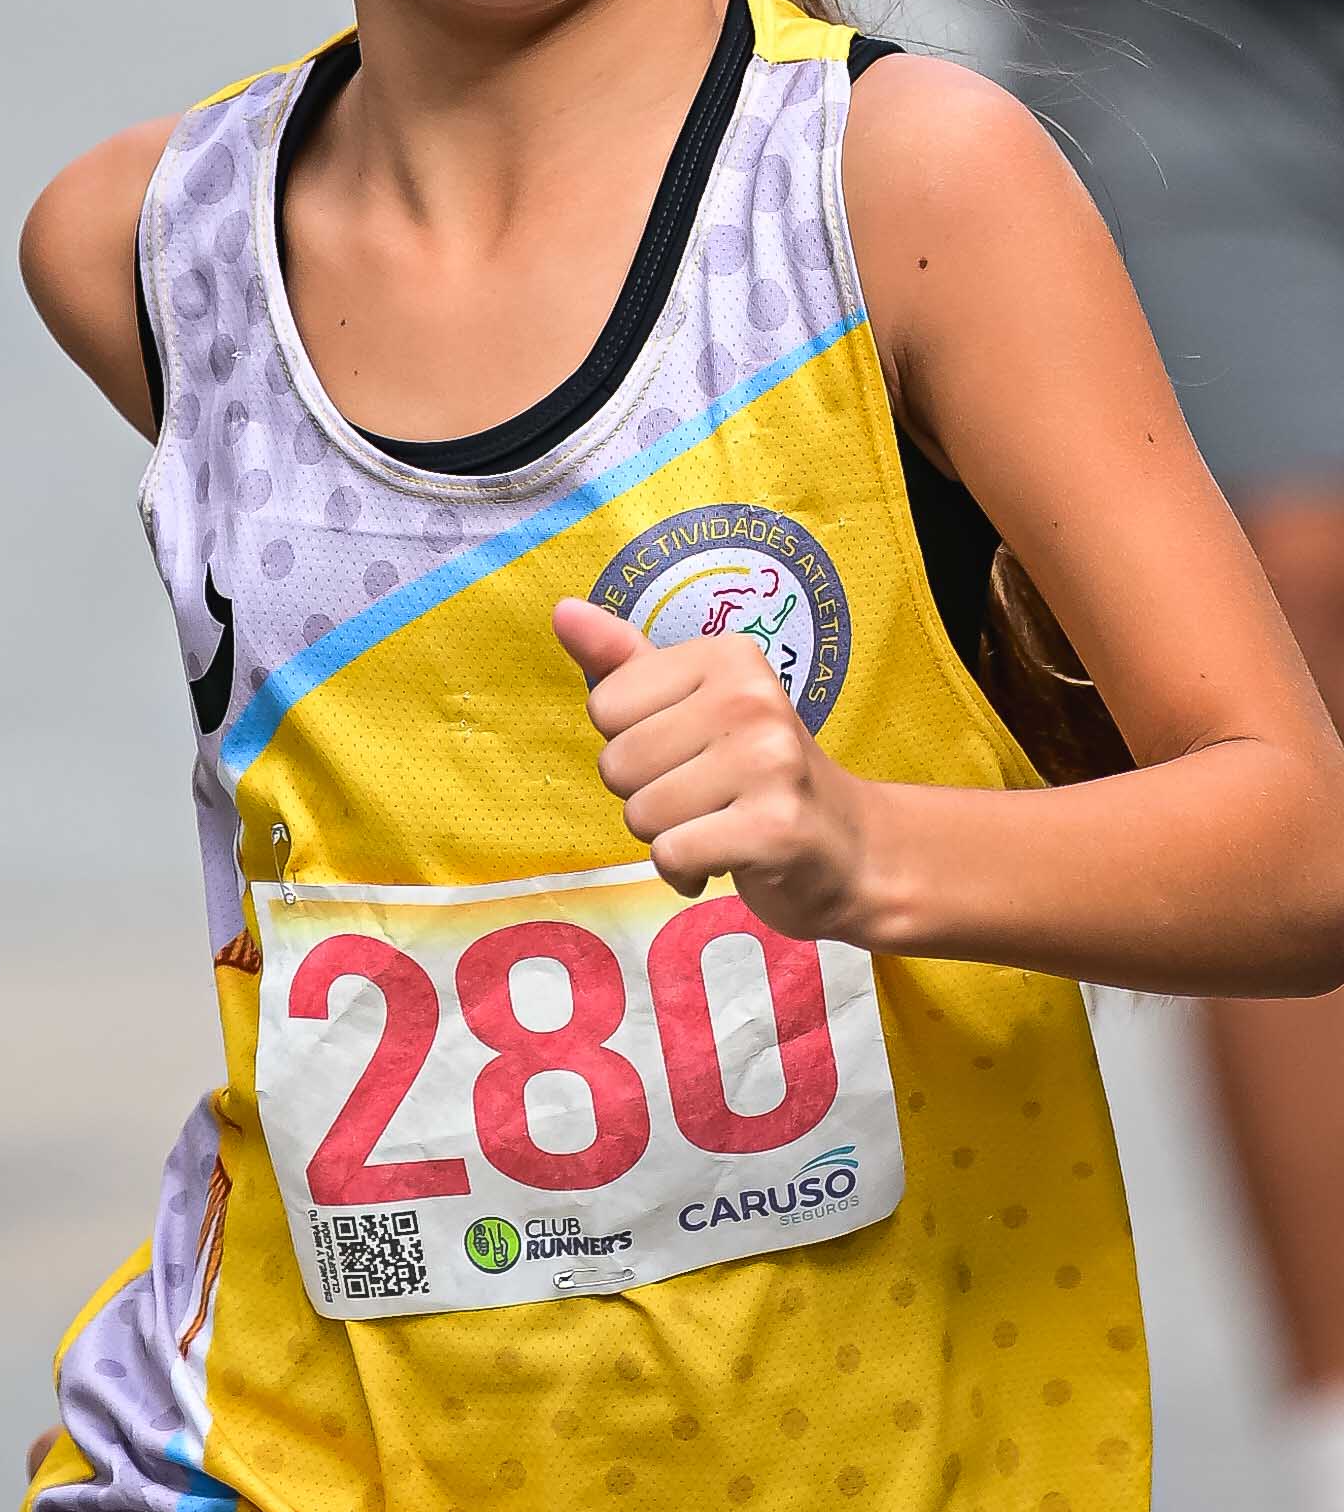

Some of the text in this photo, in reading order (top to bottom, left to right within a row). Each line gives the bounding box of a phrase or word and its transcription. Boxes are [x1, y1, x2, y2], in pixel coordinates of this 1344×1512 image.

[621, 517, 799, 589] ACTIVIDADES
[287, 894, 839, 1206] 280
[678, 1168, 857, 1232] CARUSO
[779, 1195, 860, 1226] SEGUROS
[525, 1218, 581, 1238] CLUB
[526, 1230, 633, 1261] RUNNER'S
